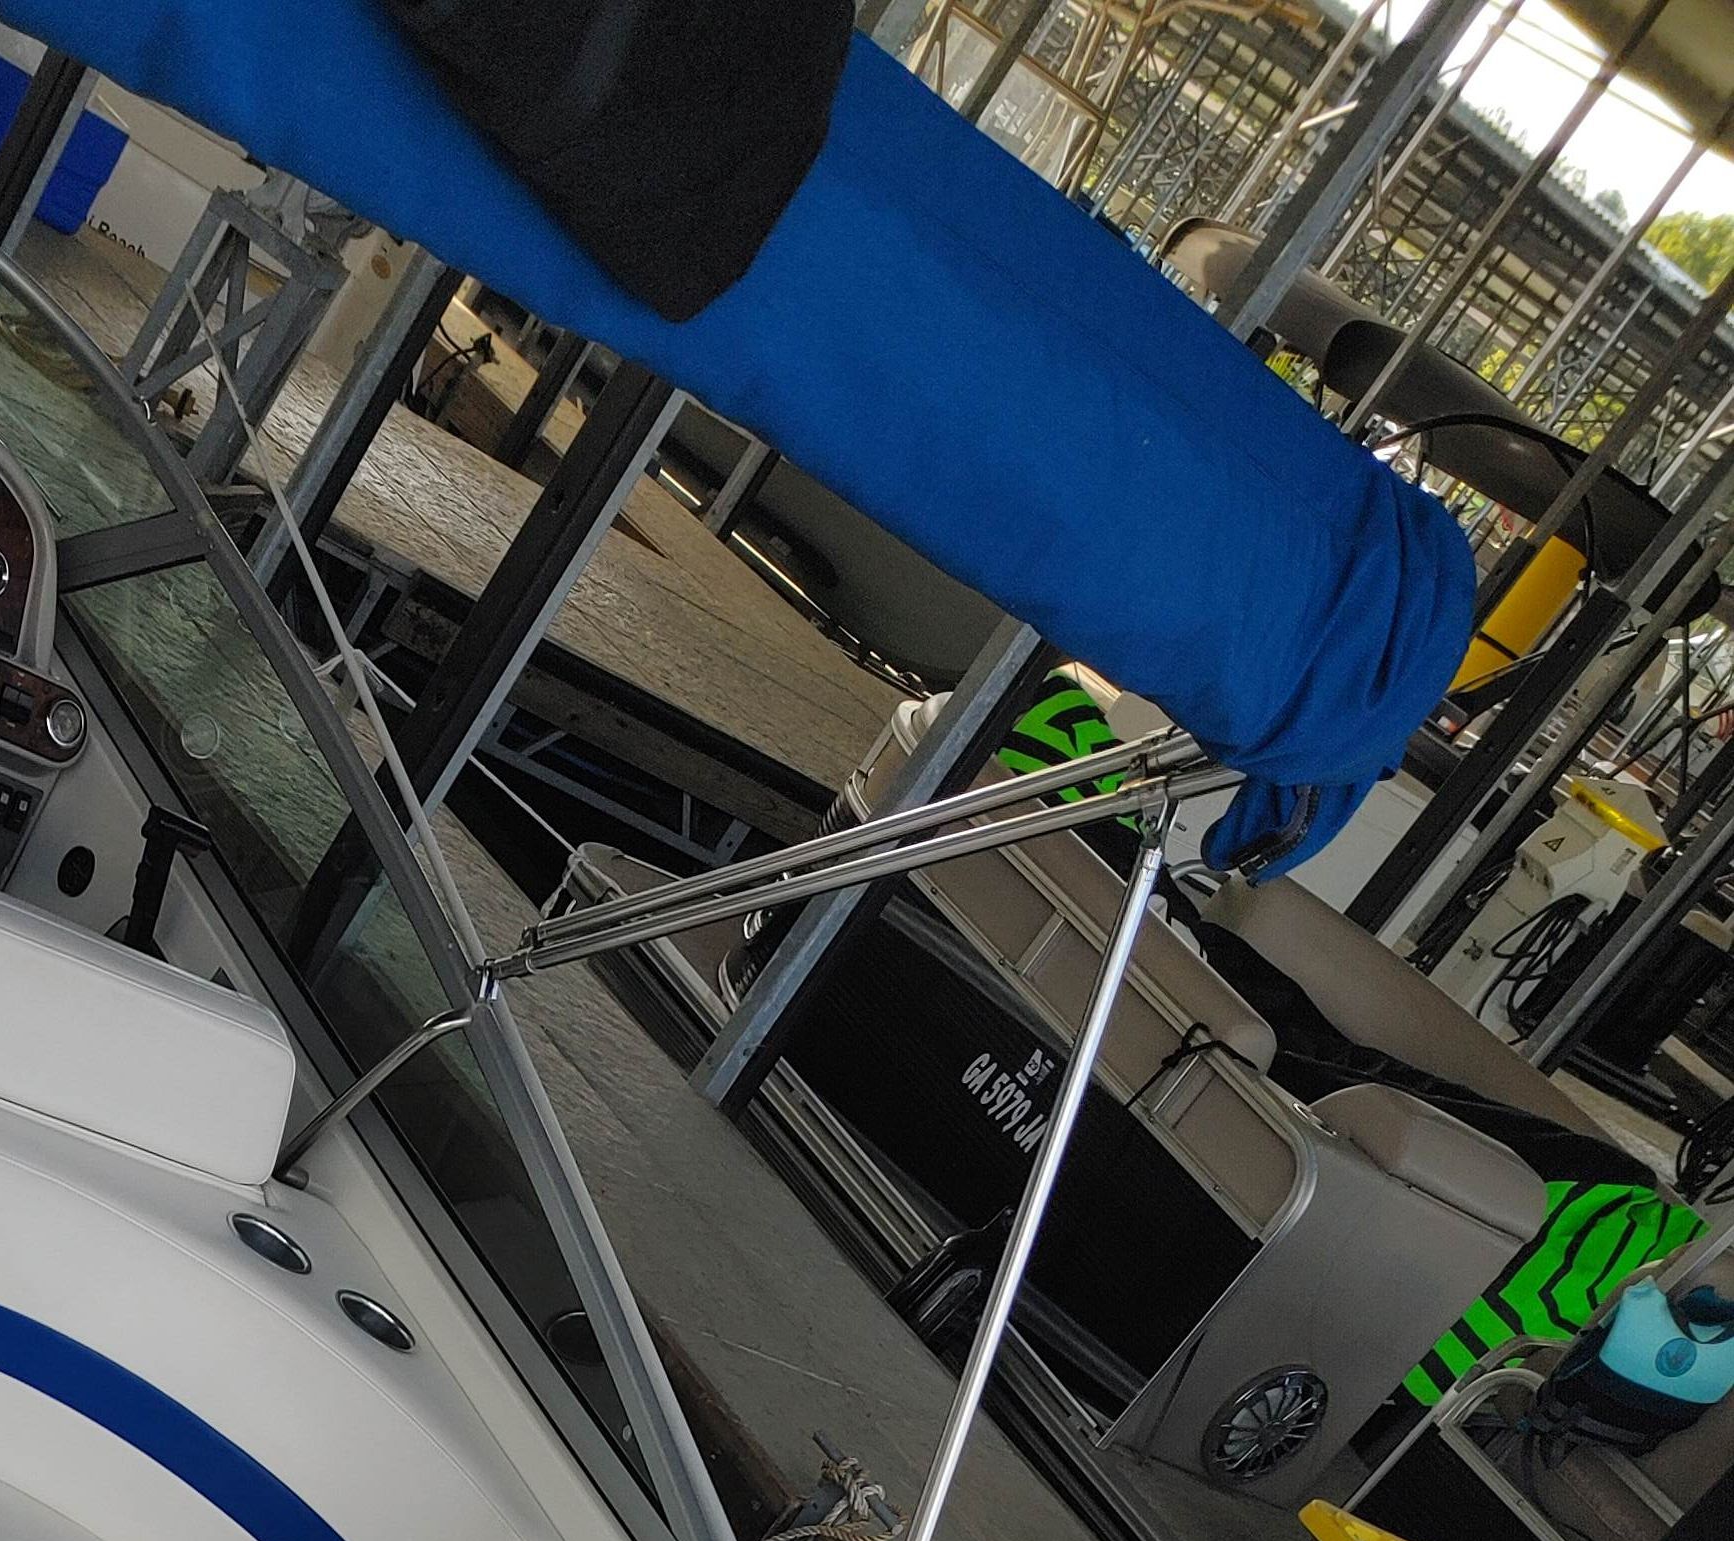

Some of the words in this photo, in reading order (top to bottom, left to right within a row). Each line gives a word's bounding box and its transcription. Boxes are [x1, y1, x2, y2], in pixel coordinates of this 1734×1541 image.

[962, 1053, 998, 1095] GA
[980, 1072, 1032, 1133] 5979
[1013, 1113, 1048, 1154] JA
